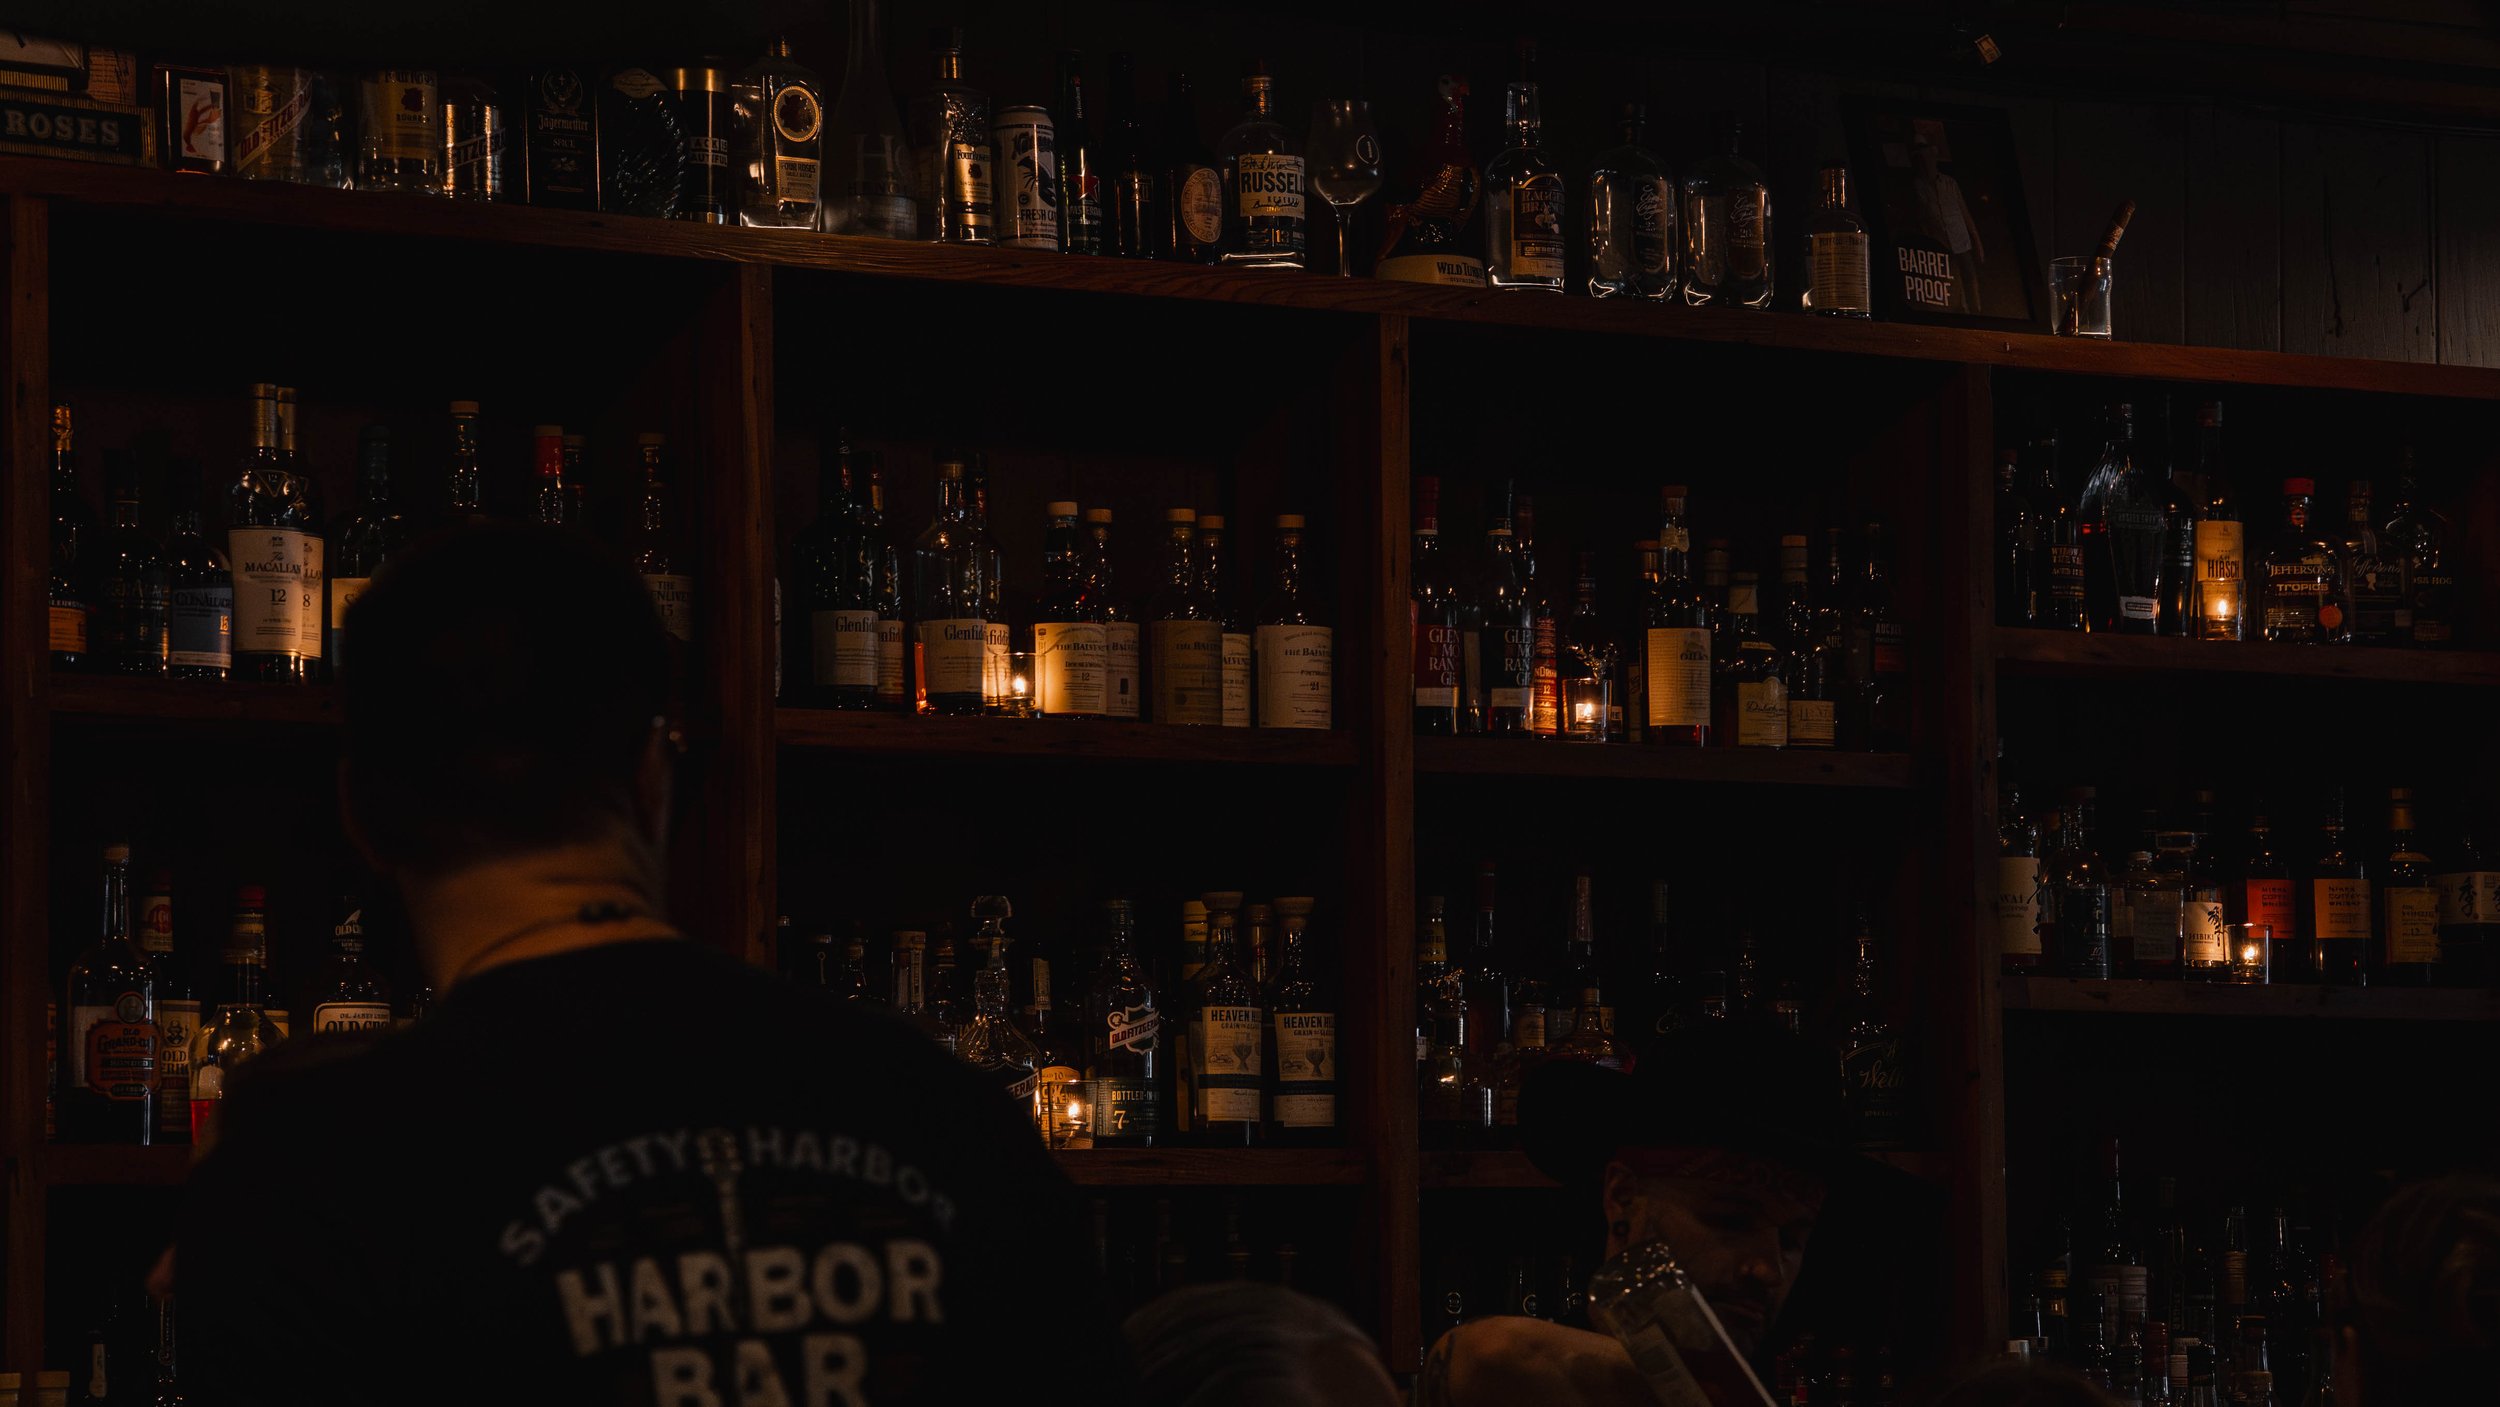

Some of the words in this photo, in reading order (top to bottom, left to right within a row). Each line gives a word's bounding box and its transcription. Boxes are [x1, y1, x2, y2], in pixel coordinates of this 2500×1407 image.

[4, 108, 120, 146] ROSES
[1240, 171, 1303, 195] RUSSELL
[1021, 209, 1047, 221] FRESH
[1436, 261, 1461, 276] WILD
[1897, 246, 1954, 280] BARREL
[1904, 275, 1952, 307] PROOF
[2207, 560, 2240, 578] HIRSCH
[271, 588, 287, 602] 12
[302, 593, 311, 608] 8
[835, 616, 874, 633] Glenfid
[944, 624, 983, 641] Glenfid
[1428, 657, 1455, 671] RAN
[1504, 657, 1530, 671] RAN
[1211, 1009, 1249, 1022] HEAVEN
[1283, 1015, 1321, 1029] HEAVEN
[1113, 1109, 1127, 1130] 7
[498, 1127, 690, 1268] SAFETY
[745, 1125, 957, 1233] HARBOR
[555, 1236, 945, 1359] HARBOR
[648, 1329, 873, 1407] BAR
